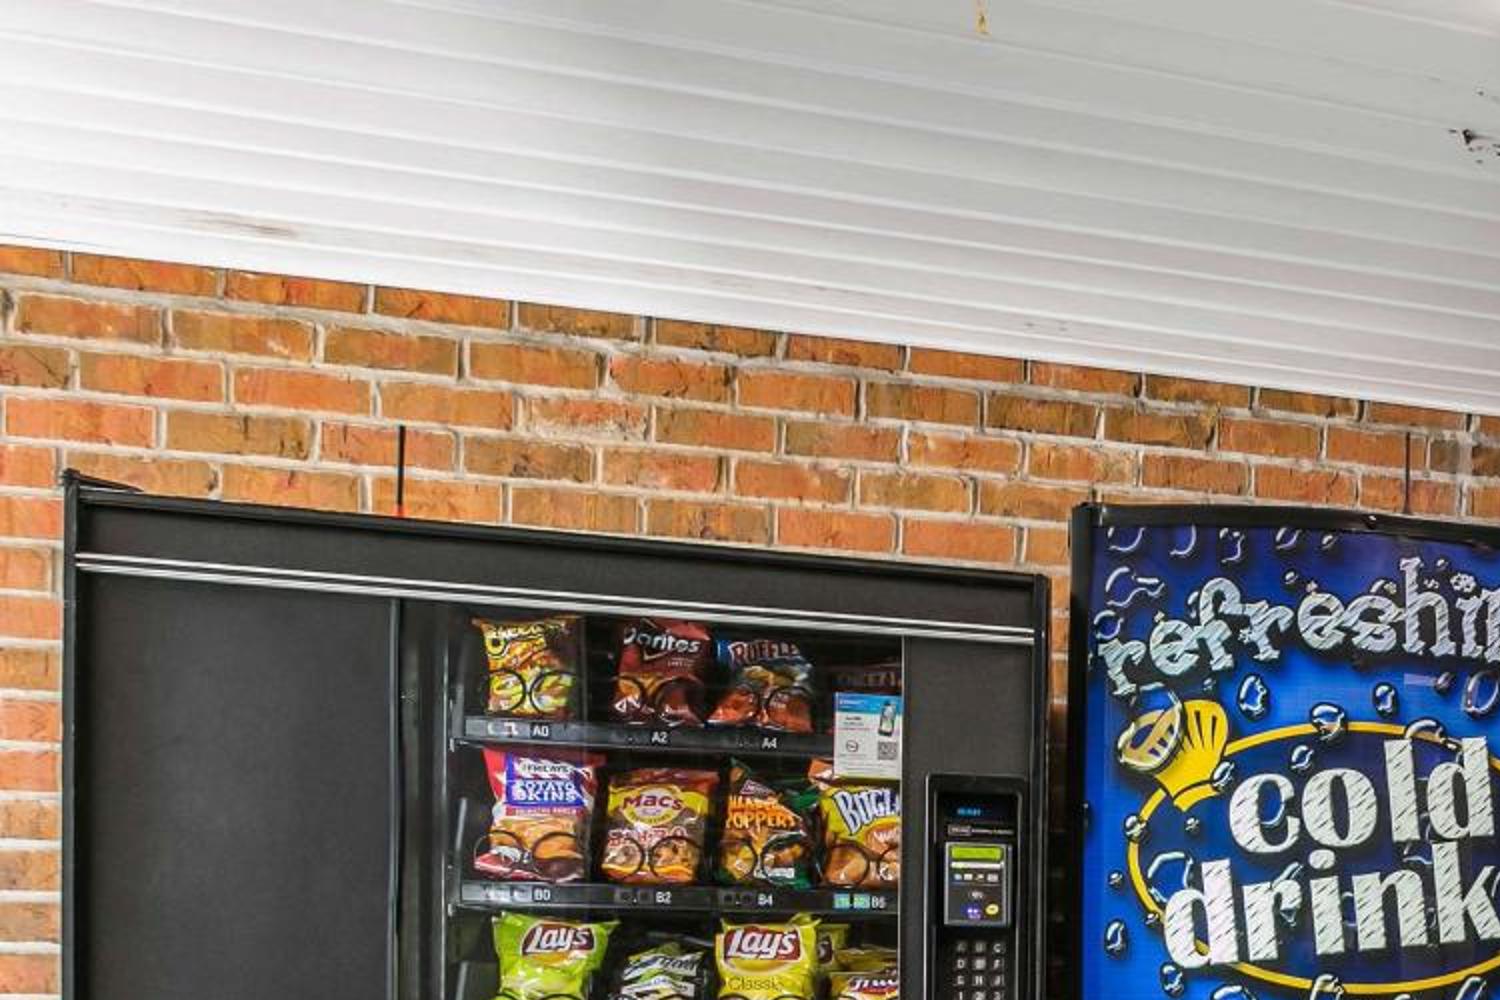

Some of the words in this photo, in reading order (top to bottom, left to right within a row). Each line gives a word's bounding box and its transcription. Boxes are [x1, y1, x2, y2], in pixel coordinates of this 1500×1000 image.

[623, 628, 700, 653] Doritos
[532, 724, 549, 737] A0
[651, 731, 668, 743] A2
[761, 737, 777, 749] A4
[1229, 737, 1495, 854] cold
[655, 891, 672, 904] B2
